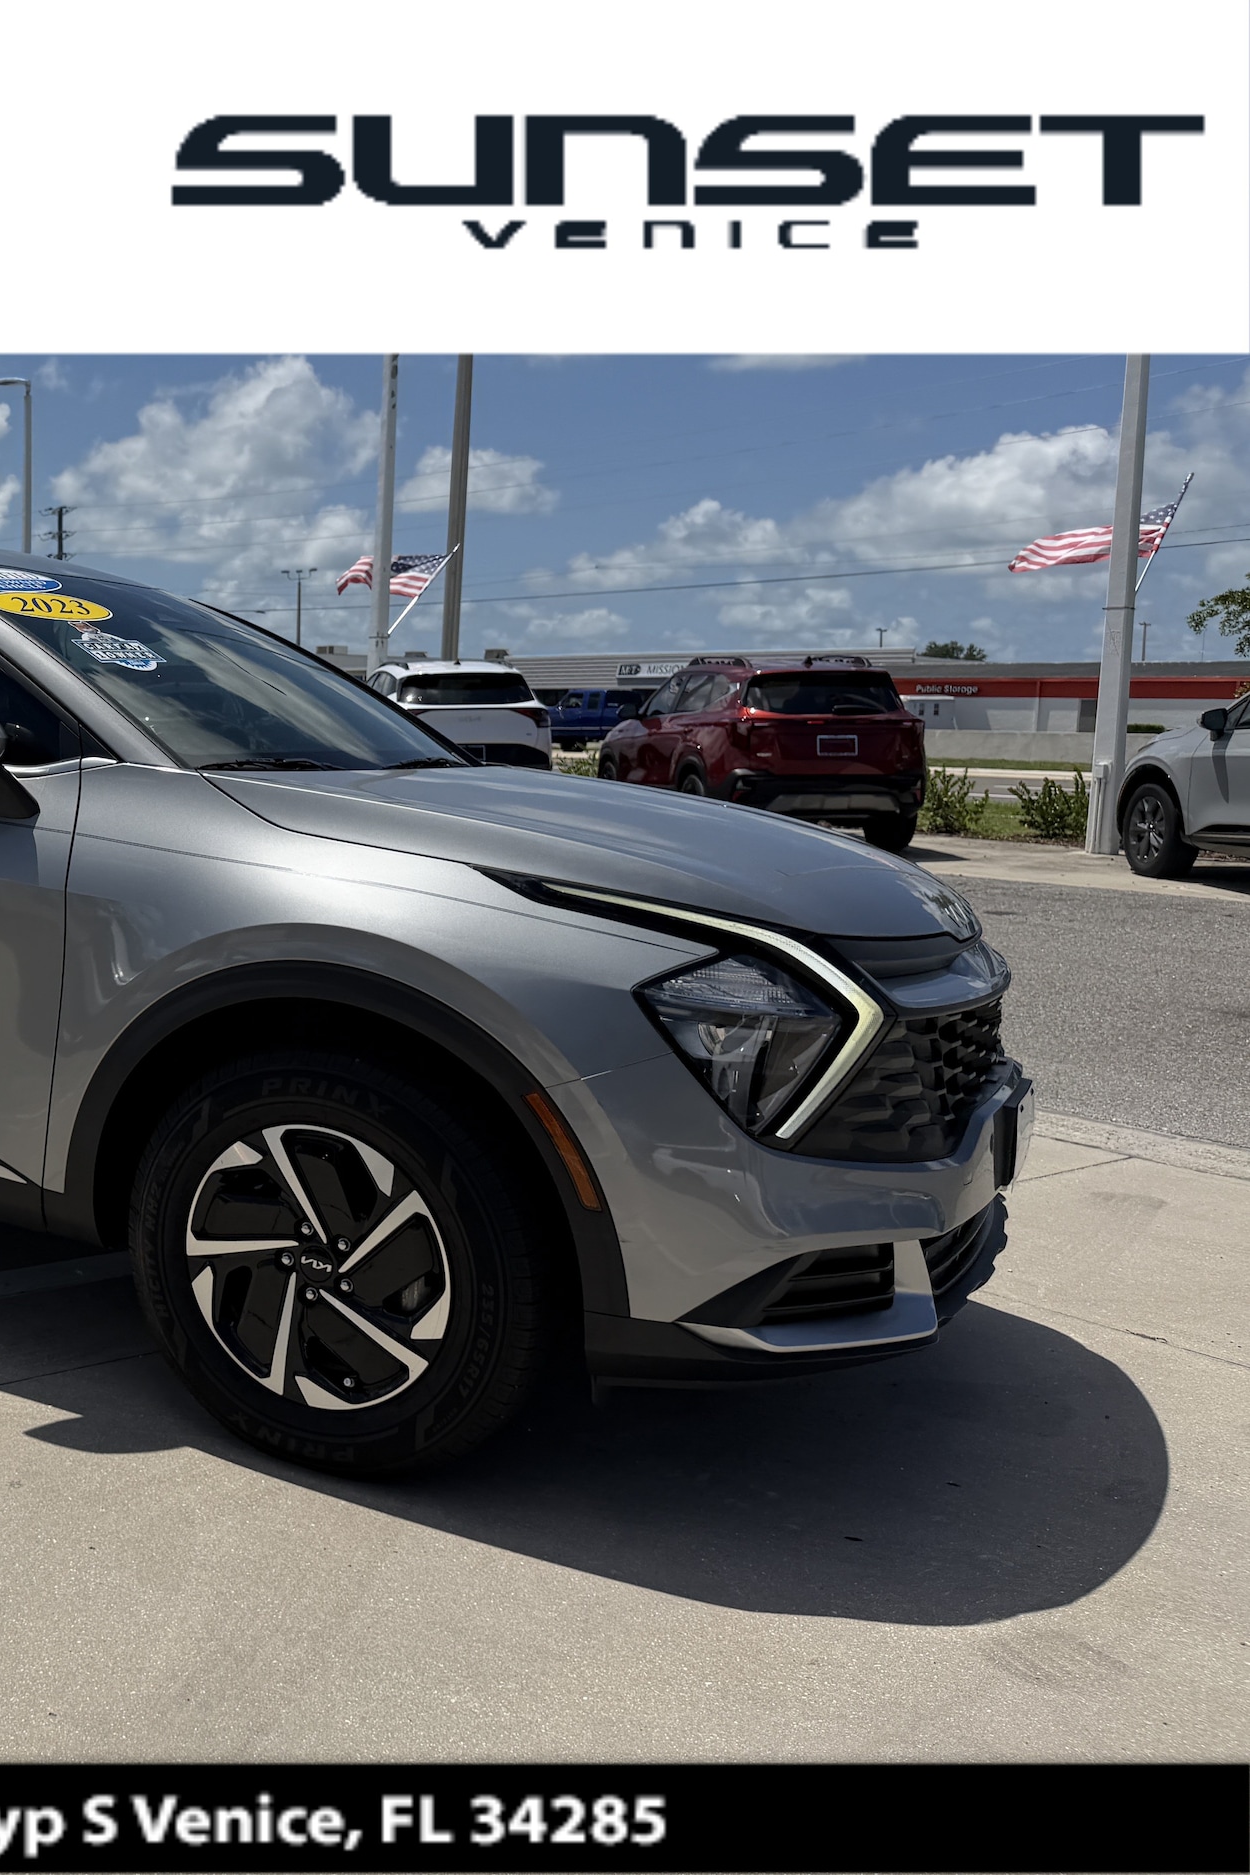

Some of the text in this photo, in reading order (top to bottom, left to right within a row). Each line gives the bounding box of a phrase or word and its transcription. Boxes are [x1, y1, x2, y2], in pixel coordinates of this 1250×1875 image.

[11, 596, 91, 615] 2023
[915, 684, 979, 695] Public Storage
[261, 1075, 393, 1120] PRINX
